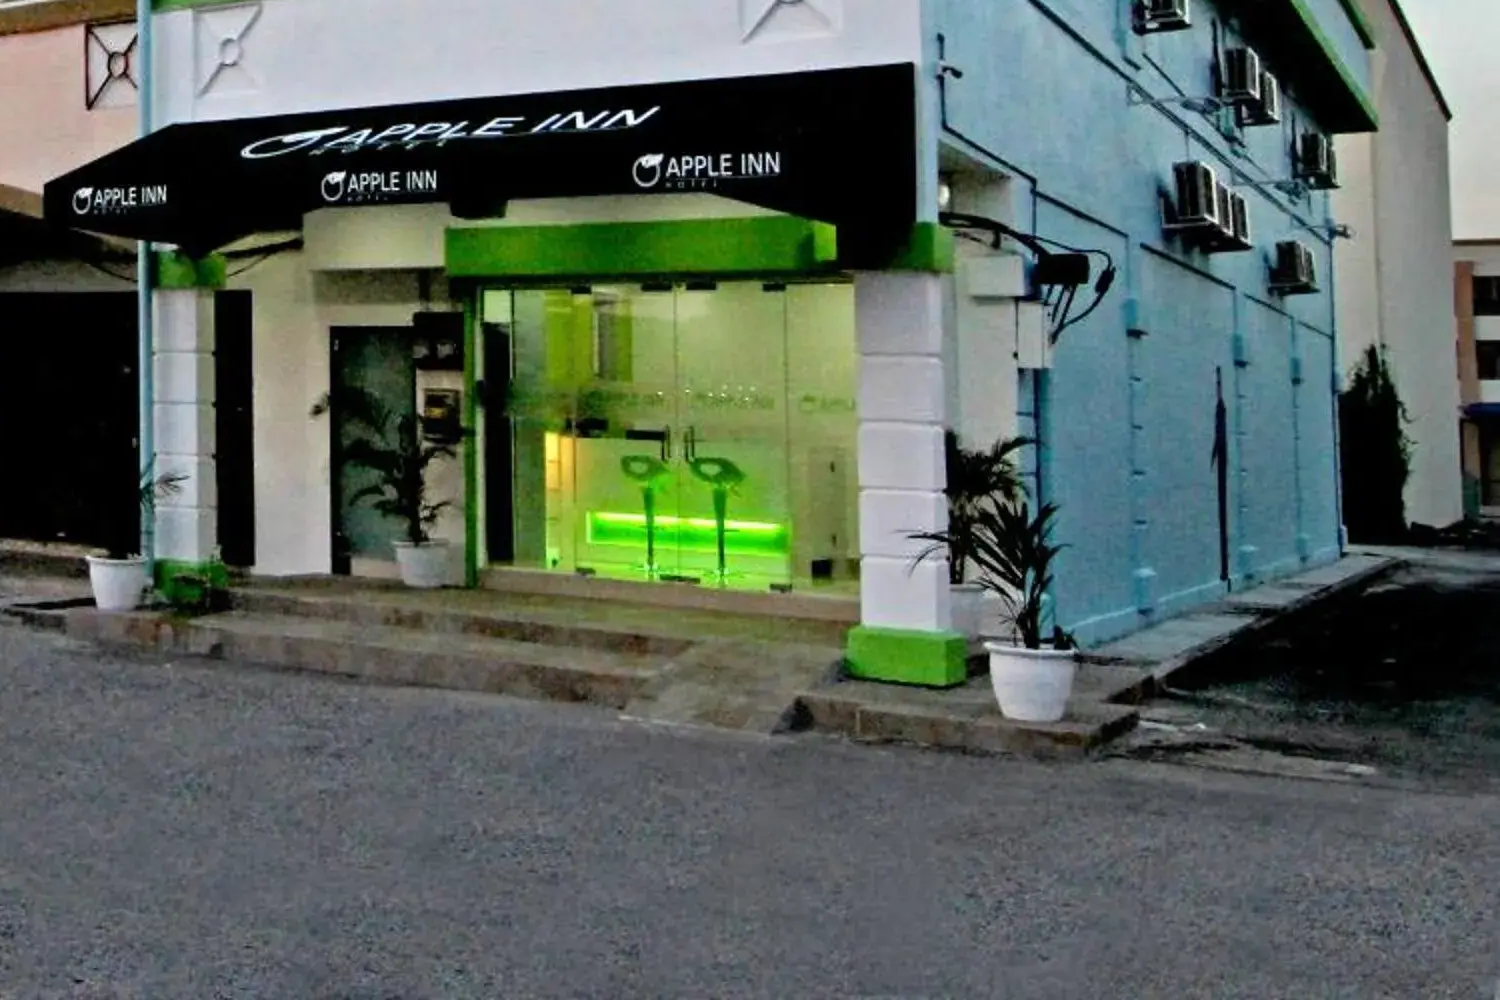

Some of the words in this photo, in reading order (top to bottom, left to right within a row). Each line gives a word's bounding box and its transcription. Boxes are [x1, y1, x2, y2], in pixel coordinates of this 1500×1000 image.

[324, 116, 526, 148] APPLE
[531, 105, 661, 134] INN
[665, 154, 734, 178] APPLE
[741, 151, 781, 175] INN
[347, 171, 401, 193] APPLE
[406, 169, 438, 192] INN
[94, 187, 137, 208] APPLE
[141, 184, 167, 205] INN
